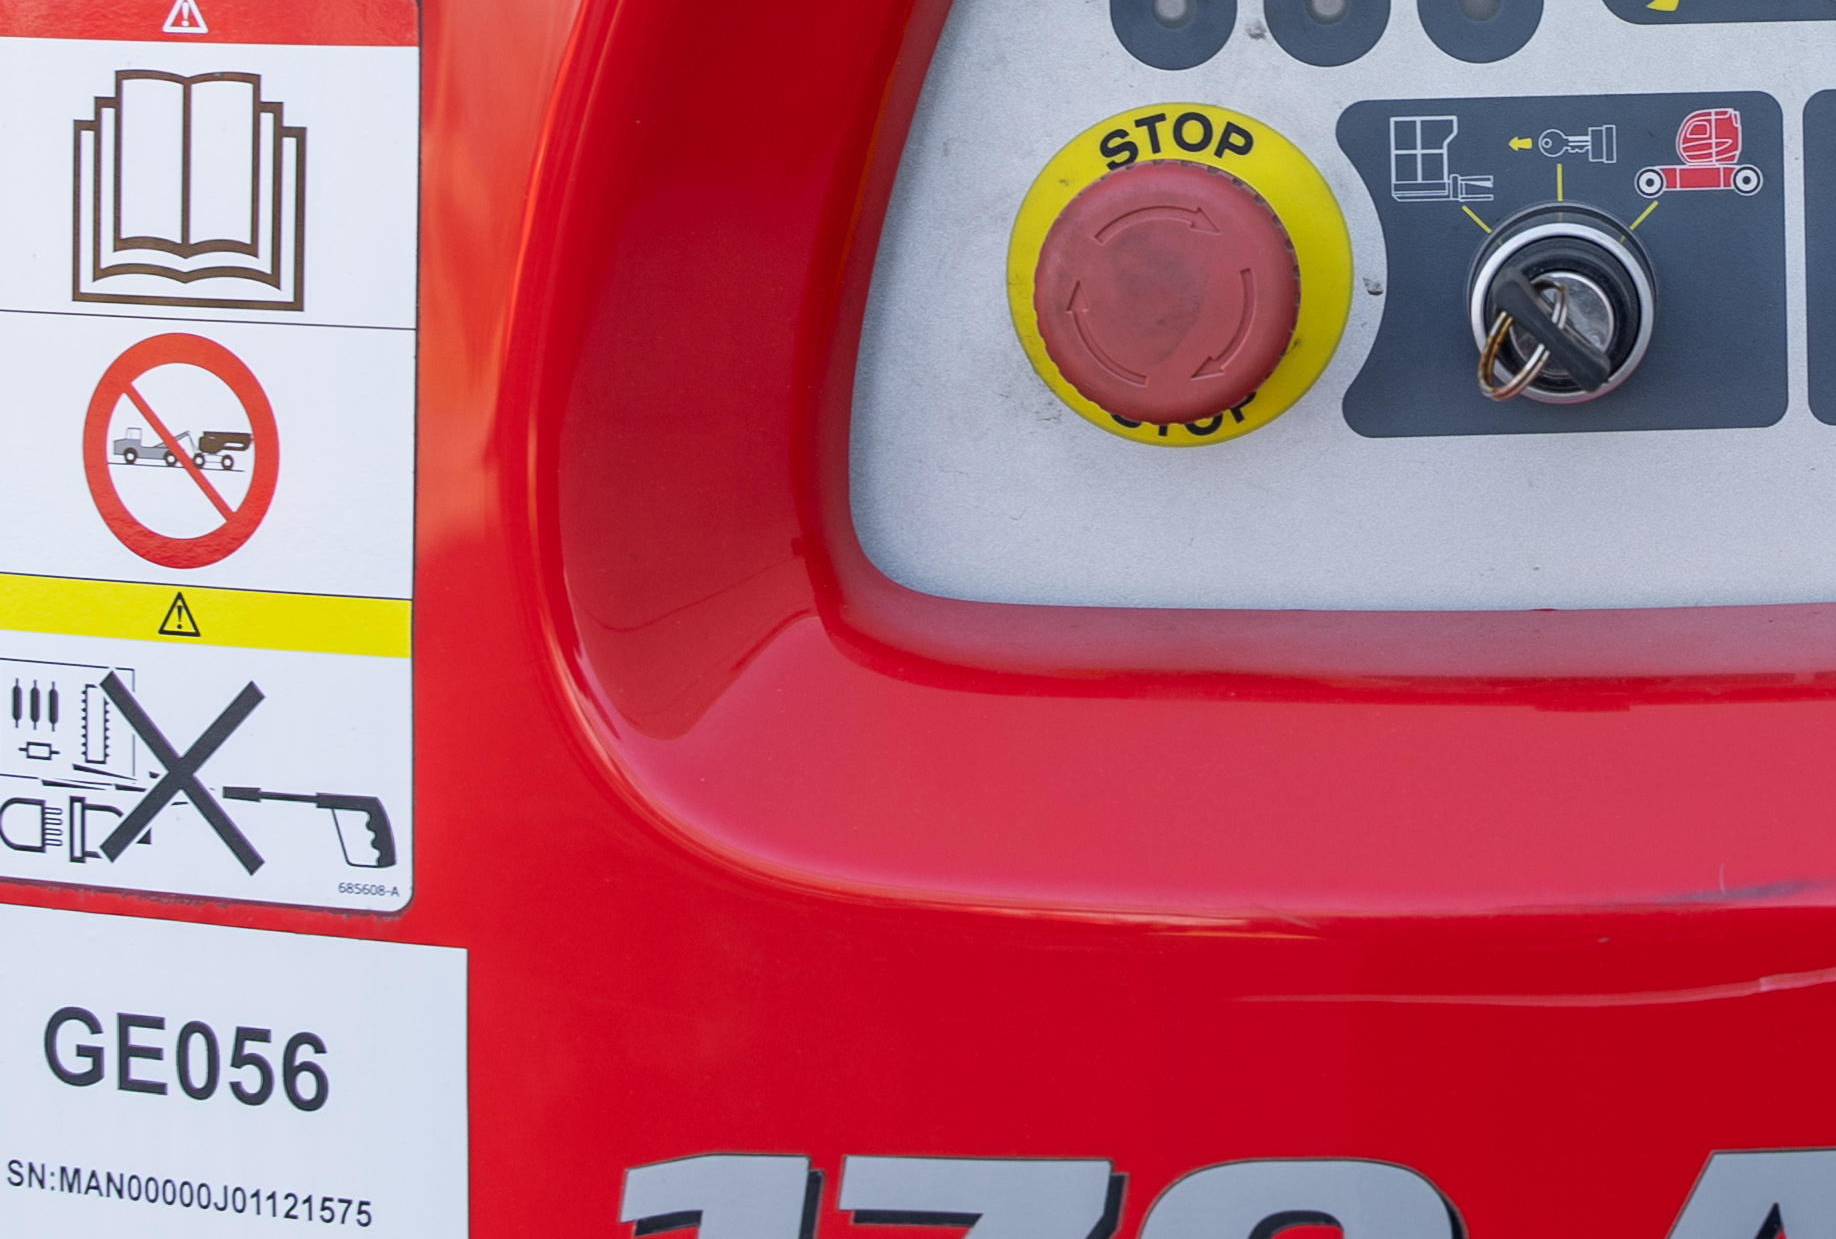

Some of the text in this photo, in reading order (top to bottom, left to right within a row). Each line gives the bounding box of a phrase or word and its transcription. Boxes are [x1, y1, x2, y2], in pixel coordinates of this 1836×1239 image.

[1099, 112, 1254, 171] STOP
[338, 882, 400, 897] 685608-A
[44, 1006, 330, 1112] GE056
[7, 1159, 373, 1228] SN:MAN00000J01121575
